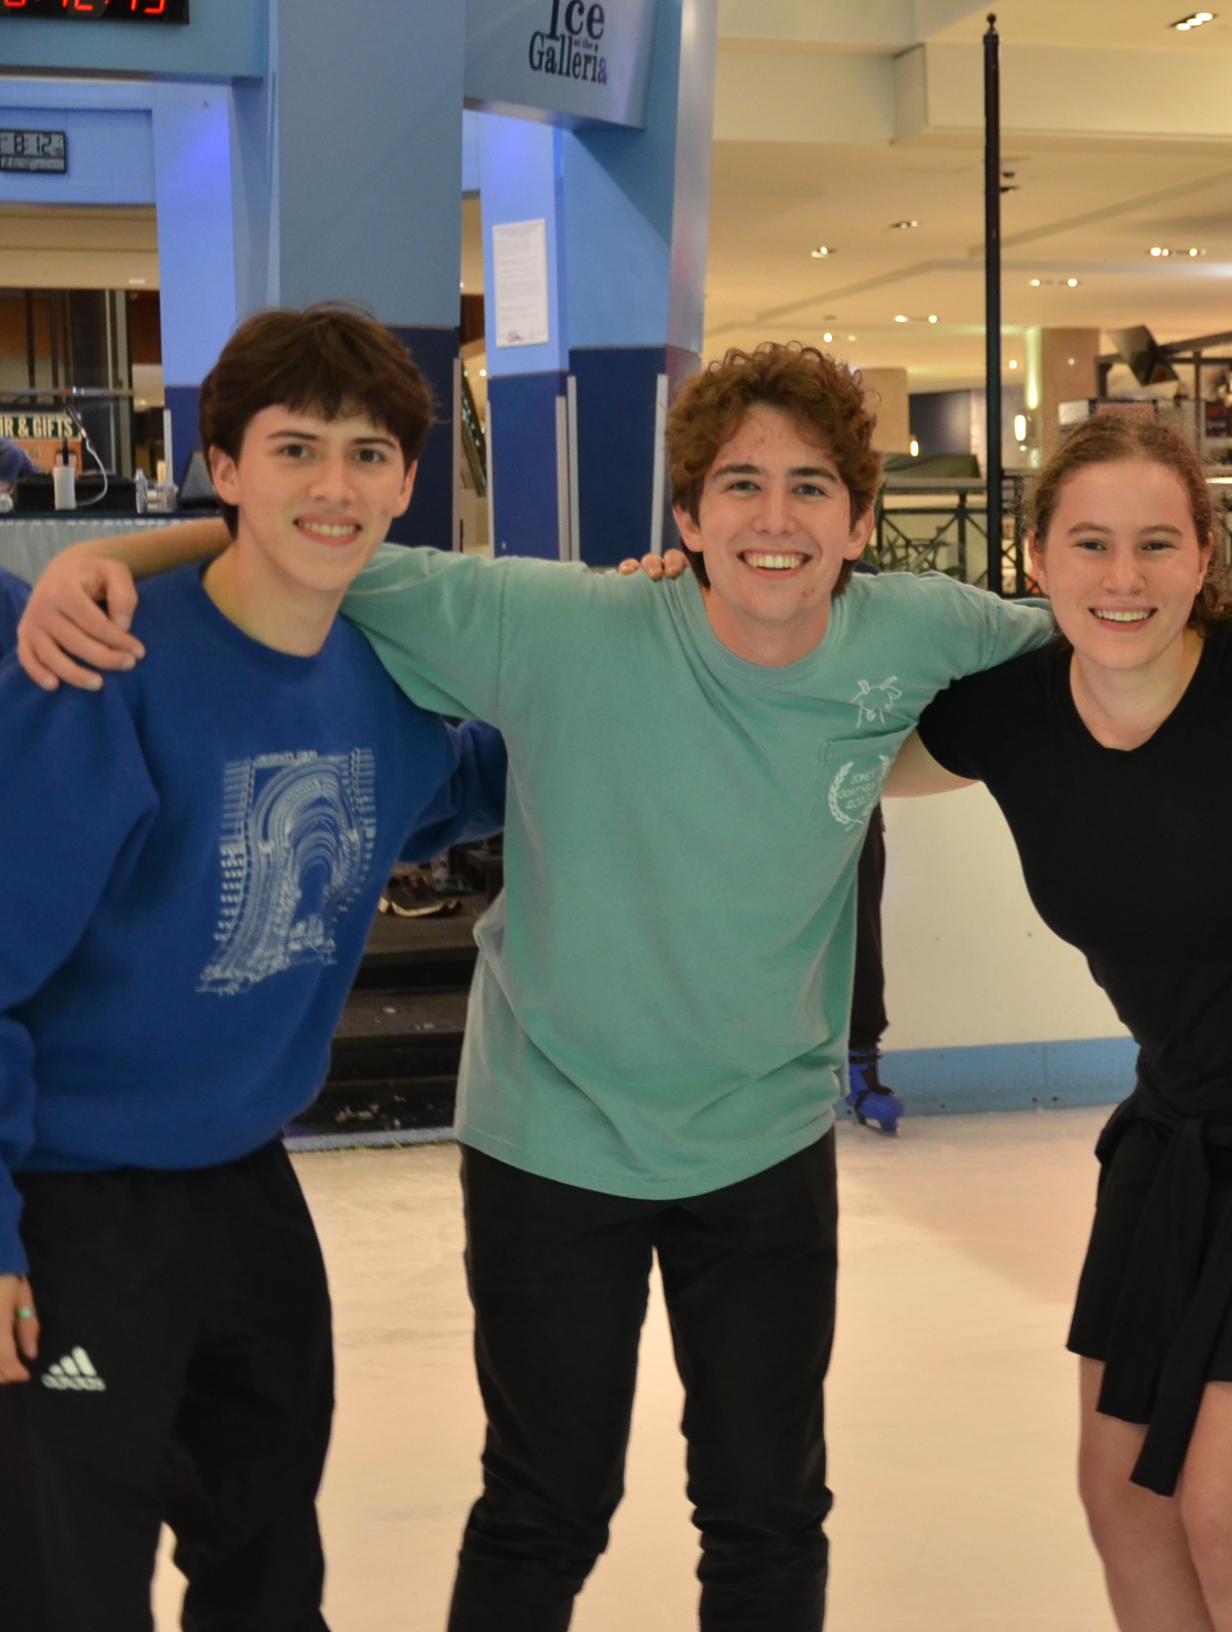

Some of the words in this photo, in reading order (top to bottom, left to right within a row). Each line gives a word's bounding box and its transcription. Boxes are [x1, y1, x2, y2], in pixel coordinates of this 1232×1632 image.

[545, 0, 604, 41] Ice
[529, 31, 607, 84] Galleria
[18, 416, 29, 438] &
[33, 416, 73, 438] GIFTS
